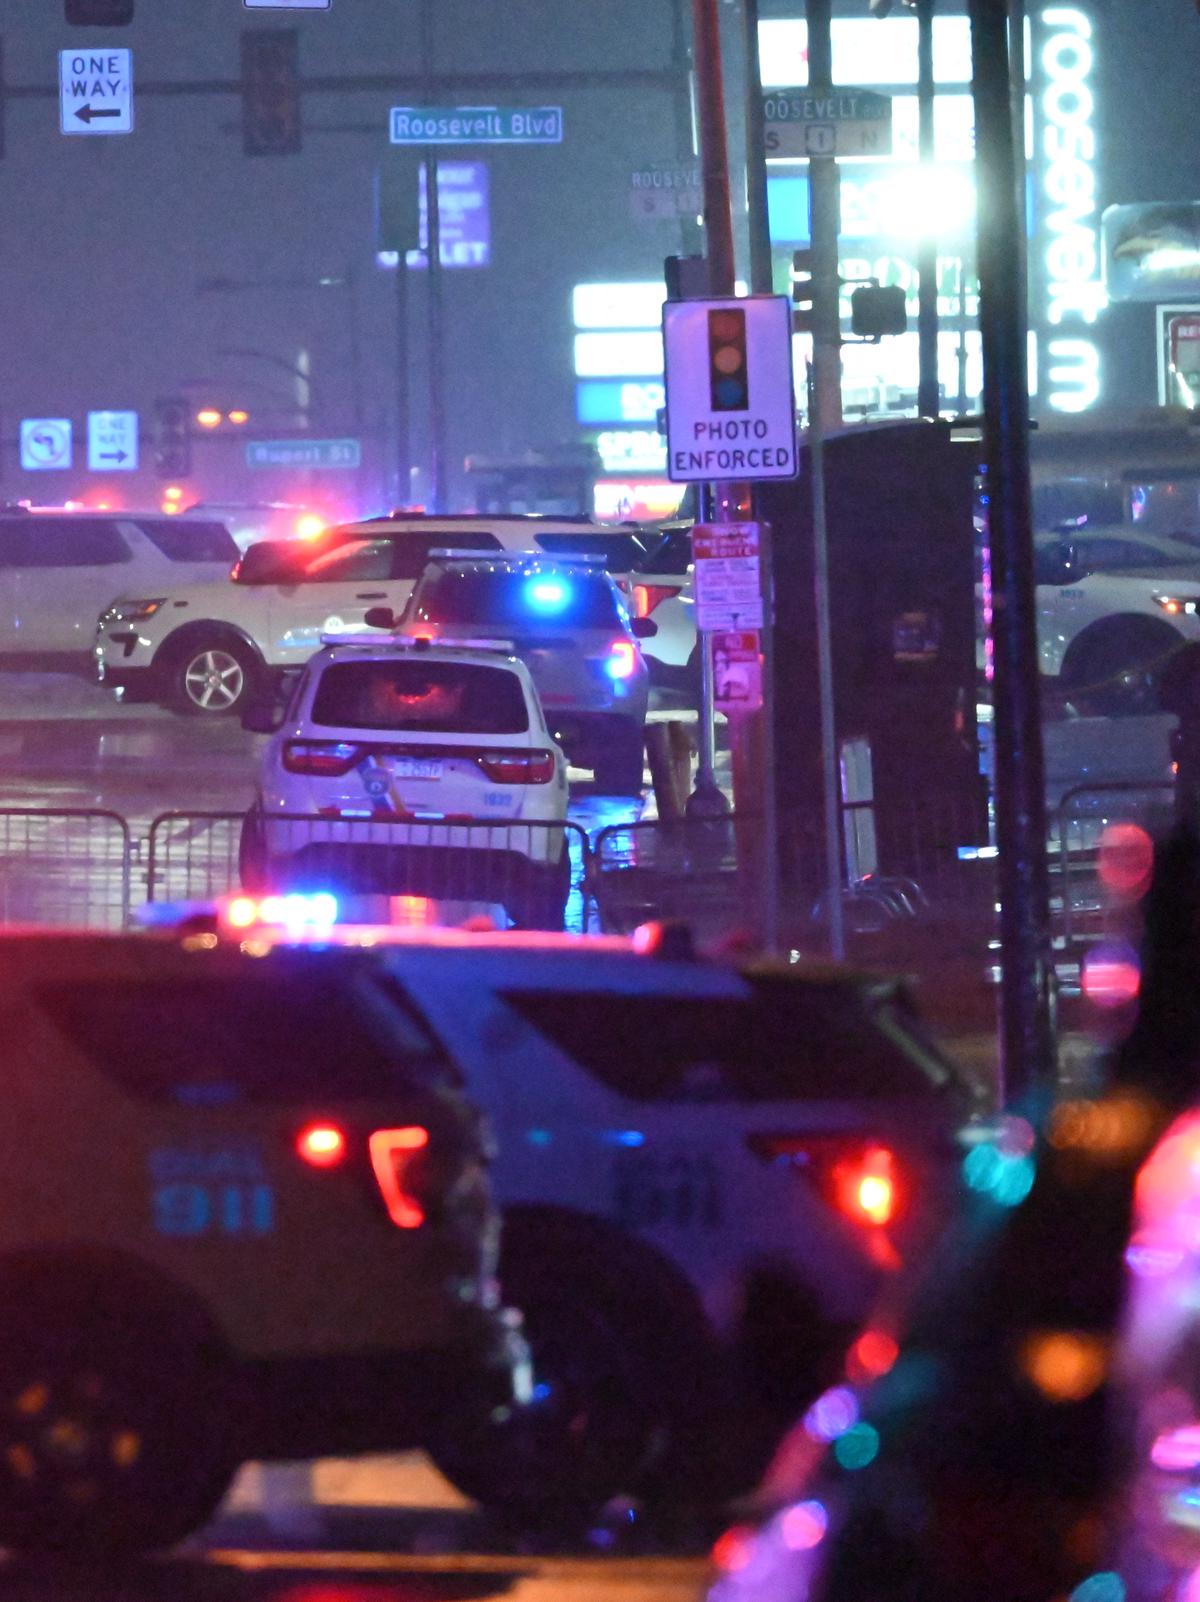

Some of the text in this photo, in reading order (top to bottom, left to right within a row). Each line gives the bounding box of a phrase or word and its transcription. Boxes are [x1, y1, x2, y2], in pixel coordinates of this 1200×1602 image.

[71, 56, 121, 75] ONE
[71, 79, 121, 97] WAY
[764, 99, 857, 119] OOSEVELT
[397, 113, 556, 136] Roosevelt Blvd
[1041, 8, 1108, 324] roosevelt
[693, 419, 768, 440] PHOTO
[675, 447, 789, 471] ENFORCED
[153, 1183, 275, 1235] 911
